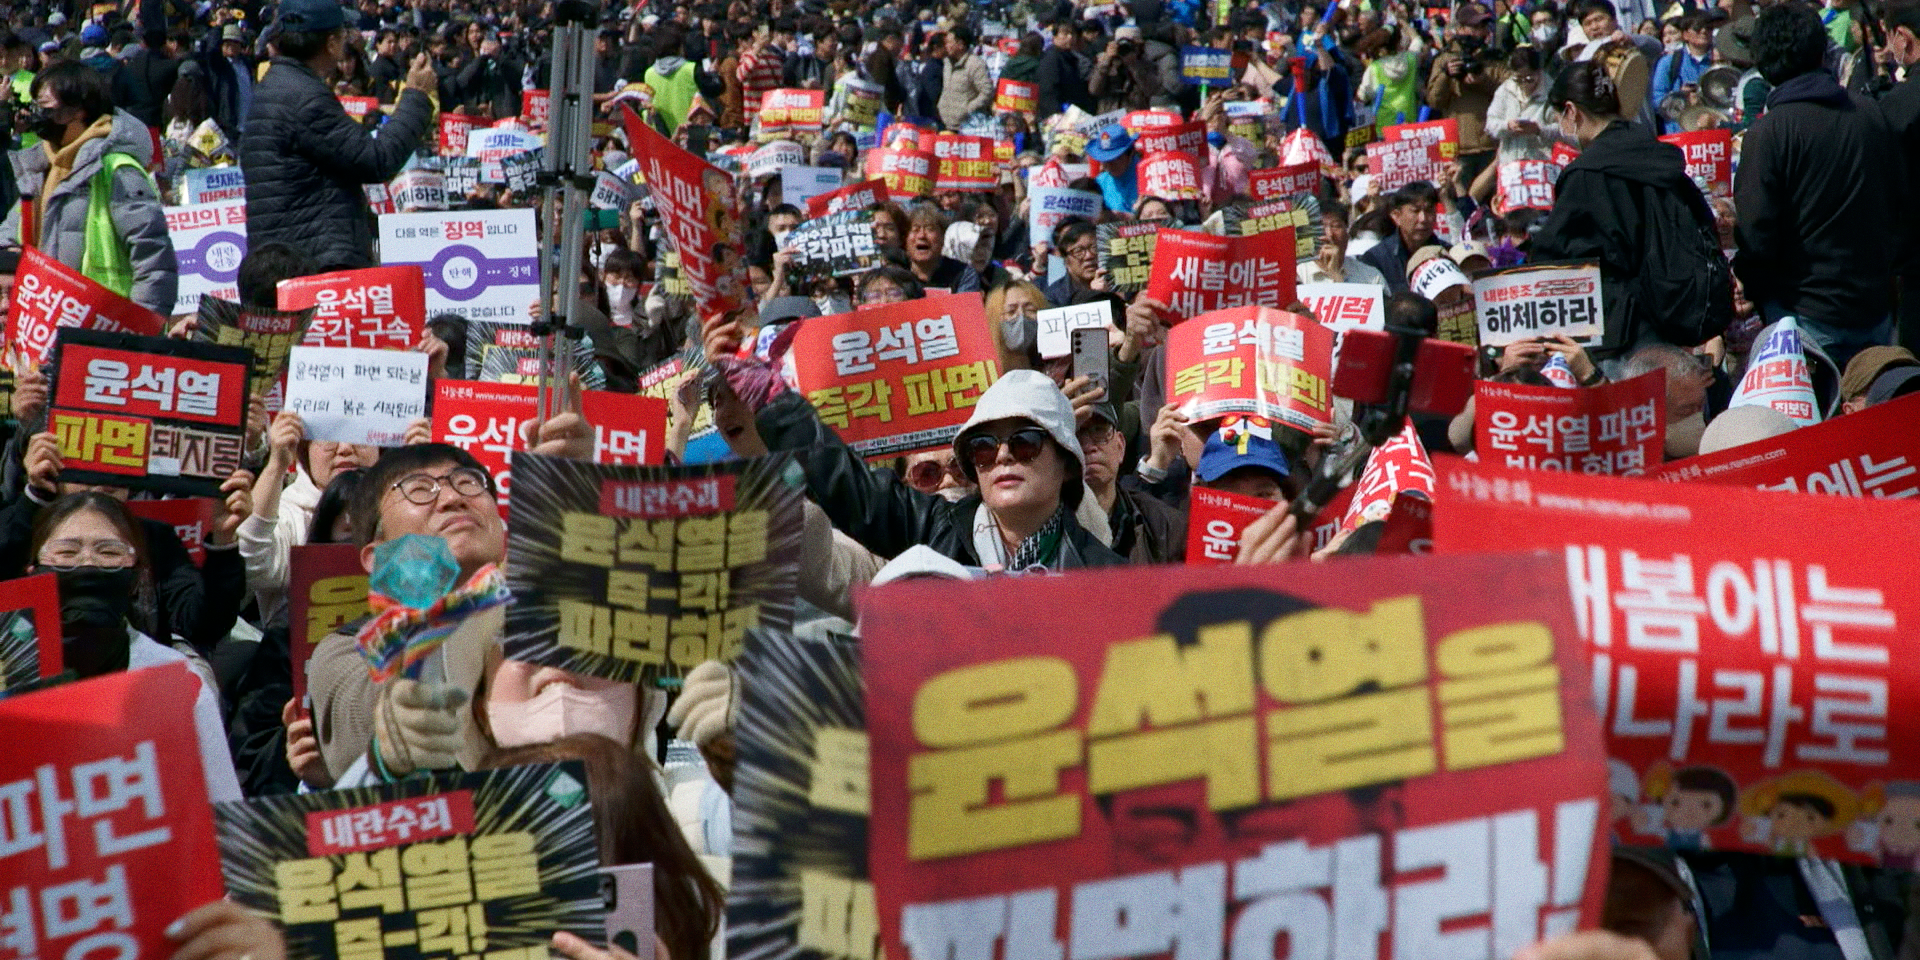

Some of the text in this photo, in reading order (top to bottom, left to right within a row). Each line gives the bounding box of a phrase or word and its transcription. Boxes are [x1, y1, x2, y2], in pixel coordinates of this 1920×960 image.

[1382, 147, 1427, 173] 윤석열
[1690, 141, 1725, 162] 파면
[1257, 175, 1295, 196] 윤석열
[395, 227, 416, 239] 다음
[509, 265, 531, 278] 징역
[1169, 256, 1281, 290] 새봄에는
[16, 273, 91, 328] 윤석열
[315, 284, 394, 316] 윤석열
[1301, 296, 1375, 325] 세력
[1485, 297, 1598, 333] 해체하라
[359, 316, 412, 346] 구속
[1042, 308, 1103, 341] 파면
[1203, 320, 1304, 362] 윤석열
[832, 313, 960, 377] 윤석열
[83, 358, 221, 417] 윤석열
[807, 358, 999, 429] 즉각 파면!
[1173, 357, 1246, 397] 즉각
[55, 413, 147, 469] 파면
[443, 413, 528, 454] 윤석
[1488, 397, 1657, 454] 윤석열 파면
[1704, 447, 1787, 476] www.nanum.com
[561, 508, 770, 571] 윤석열을
[906, 594, 1566, 862] 윤석열을
[0, 740, 172, 869] 파면
[275, 831, 541, 925] 윤석열을
